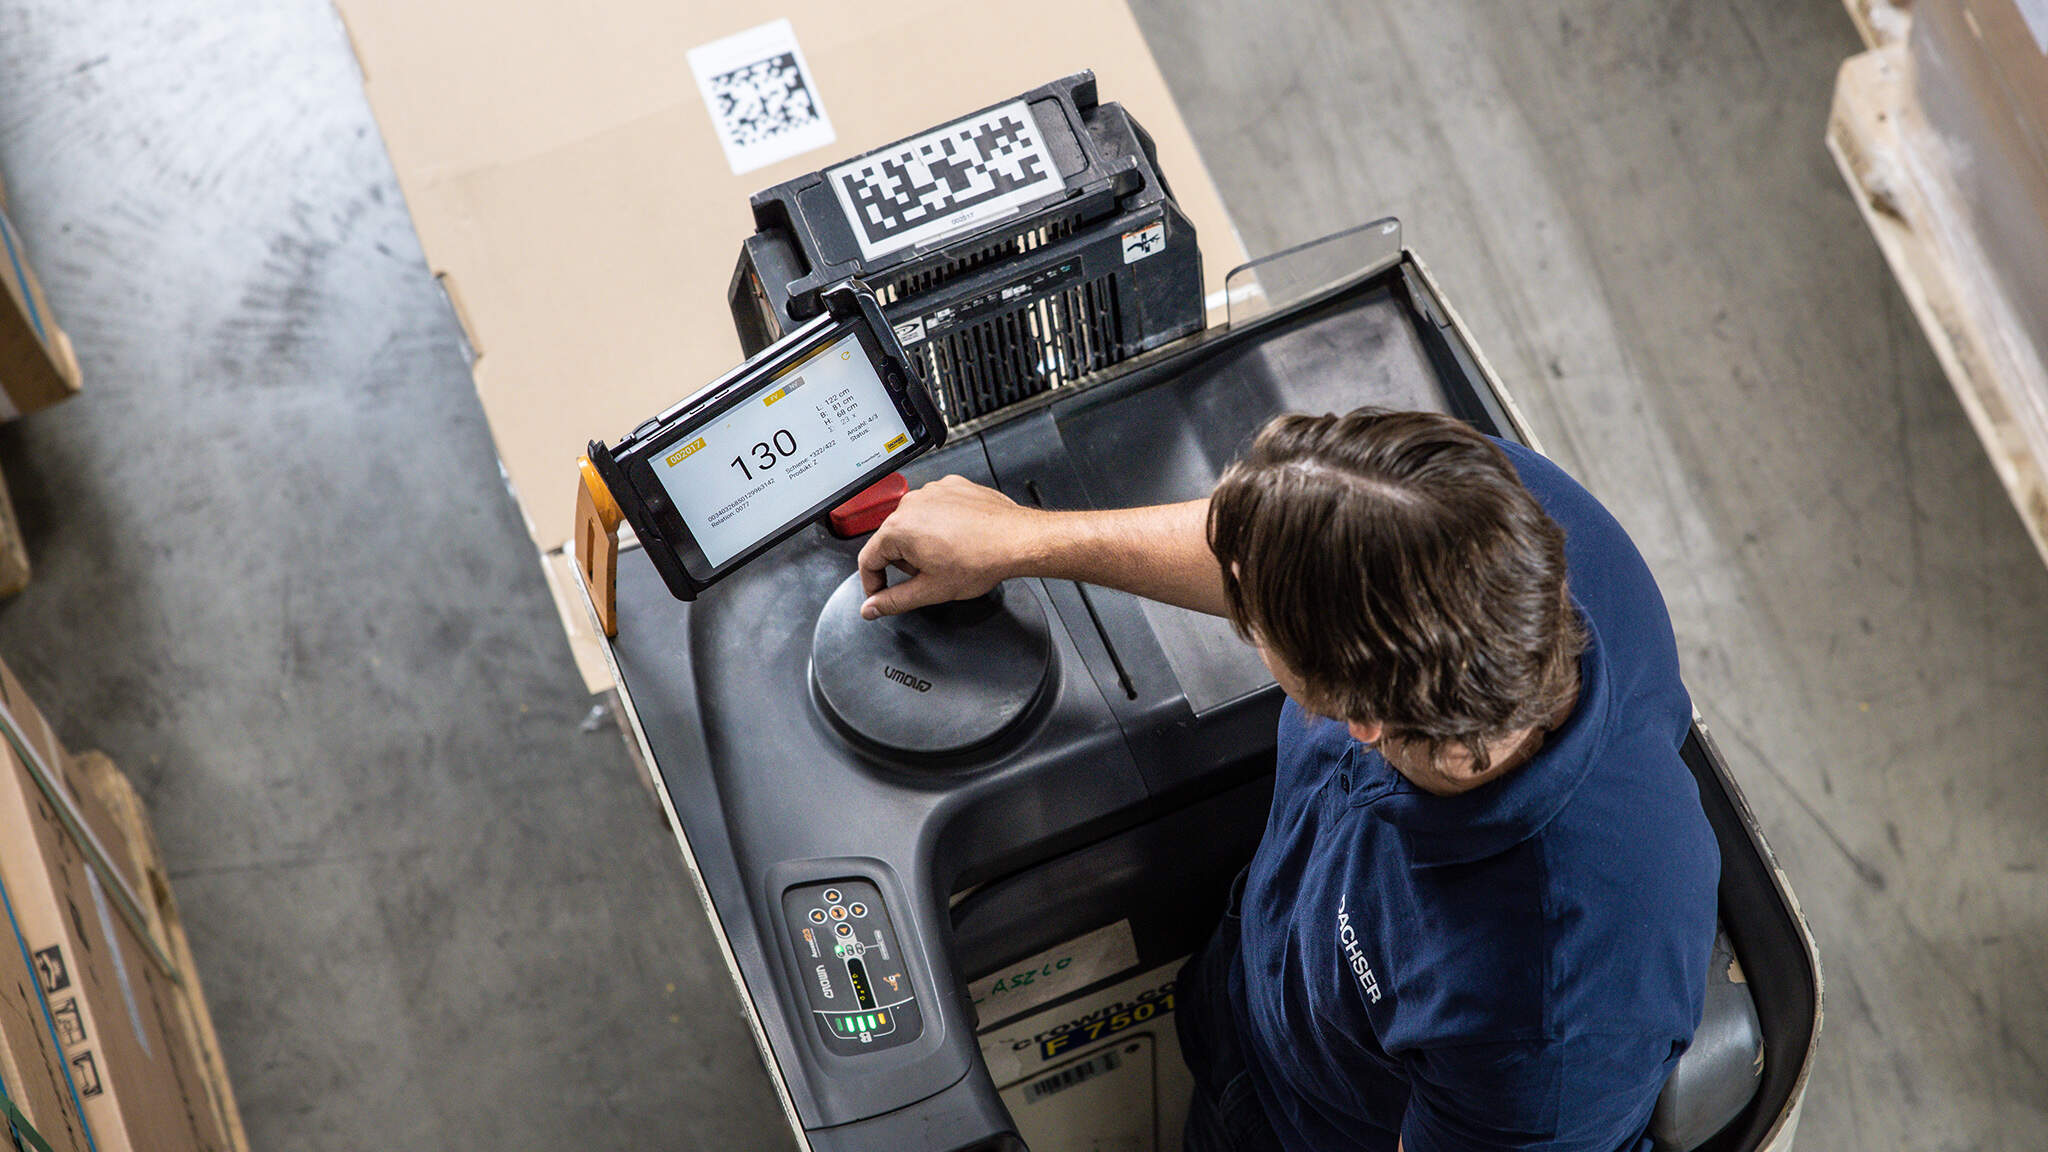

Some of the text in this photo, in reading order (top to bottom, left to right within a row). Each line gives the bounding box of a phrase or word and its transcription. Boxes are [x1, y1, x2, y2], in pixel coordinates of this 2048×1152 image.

[825, 394, 838, 406] 122
[838, 388, 850, 398] cm
[832, 401, 841, 411] 81
[843, 395, 854, 405] cm
[846, 402, 858, 412] cm
[670, 440, 701, 464] 002017
[730, 429, 797, 481] 130
[1046, 994, 1175, 1056] F 7501
